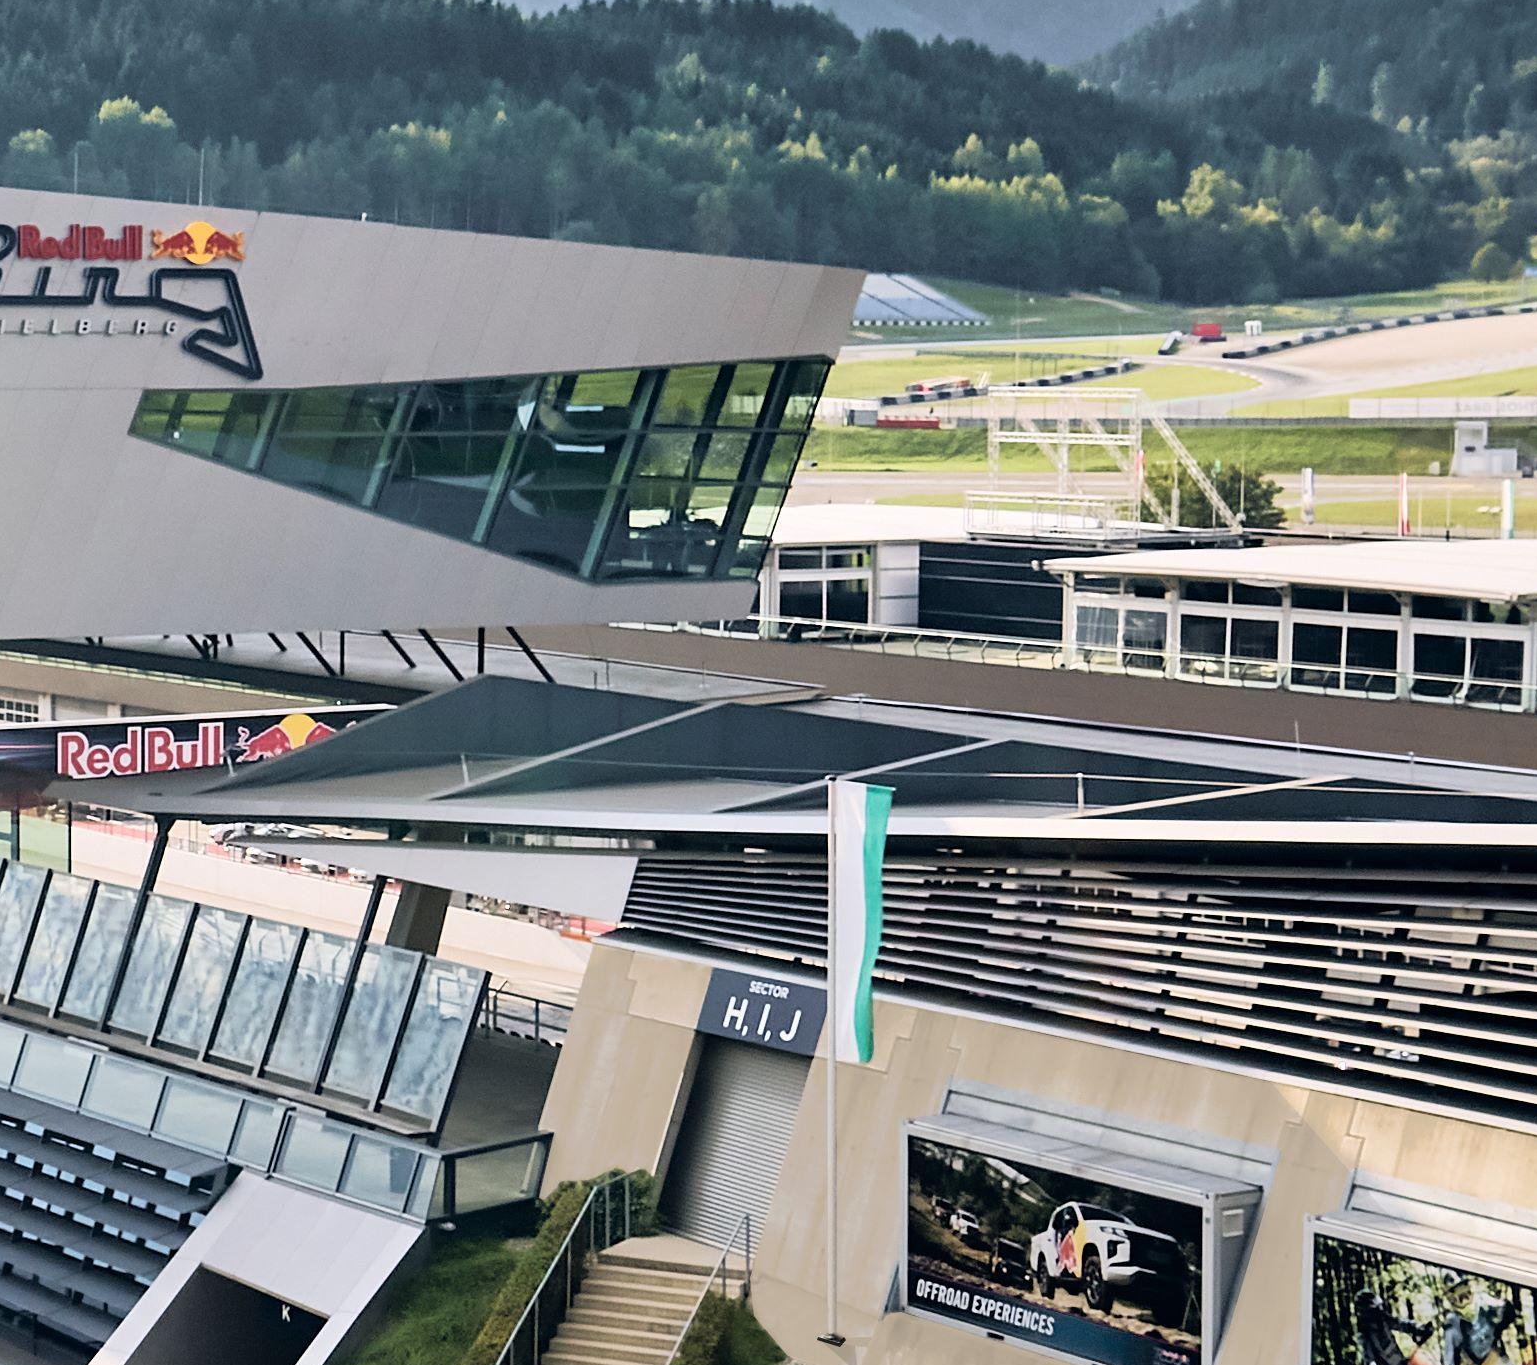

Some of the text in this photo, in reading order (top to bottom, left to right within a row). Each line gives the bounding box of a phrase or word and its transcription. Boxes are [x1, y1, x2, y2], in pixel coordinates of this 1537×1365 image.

[17, 224, 143, 261] Red Bull
[58, 722, 224, 778] Red Bull
[749, 980, 789, 999] SECTOR
[722, 996, 802, 1042] H, I, J
[916, 1279, 1055, 1336] OFFROAD EXPERIENCES
